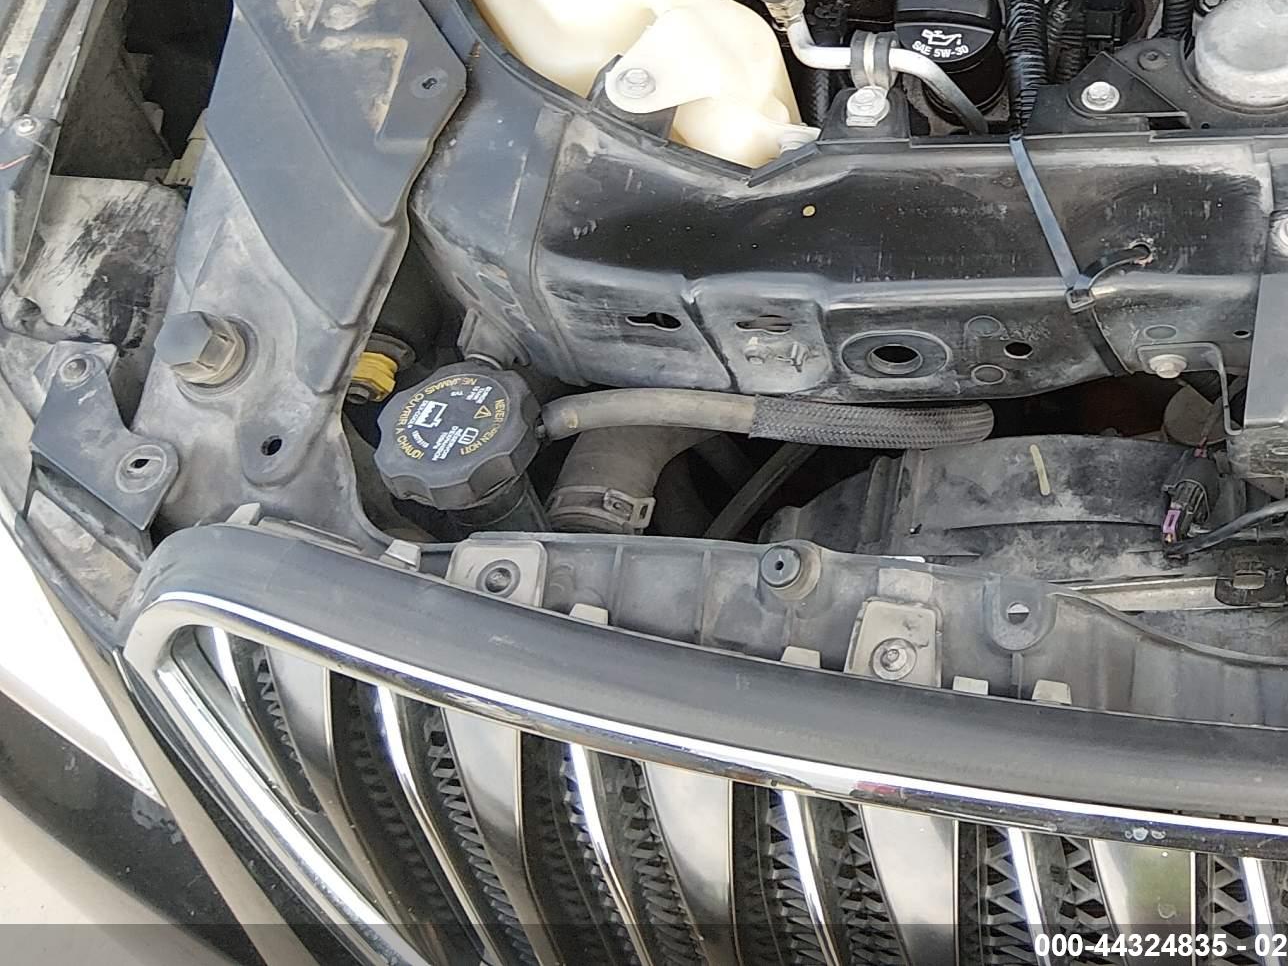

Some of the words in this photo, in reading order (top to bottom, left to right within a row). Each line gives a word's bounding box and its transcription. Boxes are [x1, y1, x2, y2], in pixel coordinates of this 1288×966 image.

[911, 40, 933, 56] SAE
[933, 44, 969, 58] 5W-30
[425, 378, 462, 395] JAMAIS
[398, 393, 425, 426] OUVRIR
[494, 398, 506, 423] NEVER
[460, 442, 482, 455] HOT!
